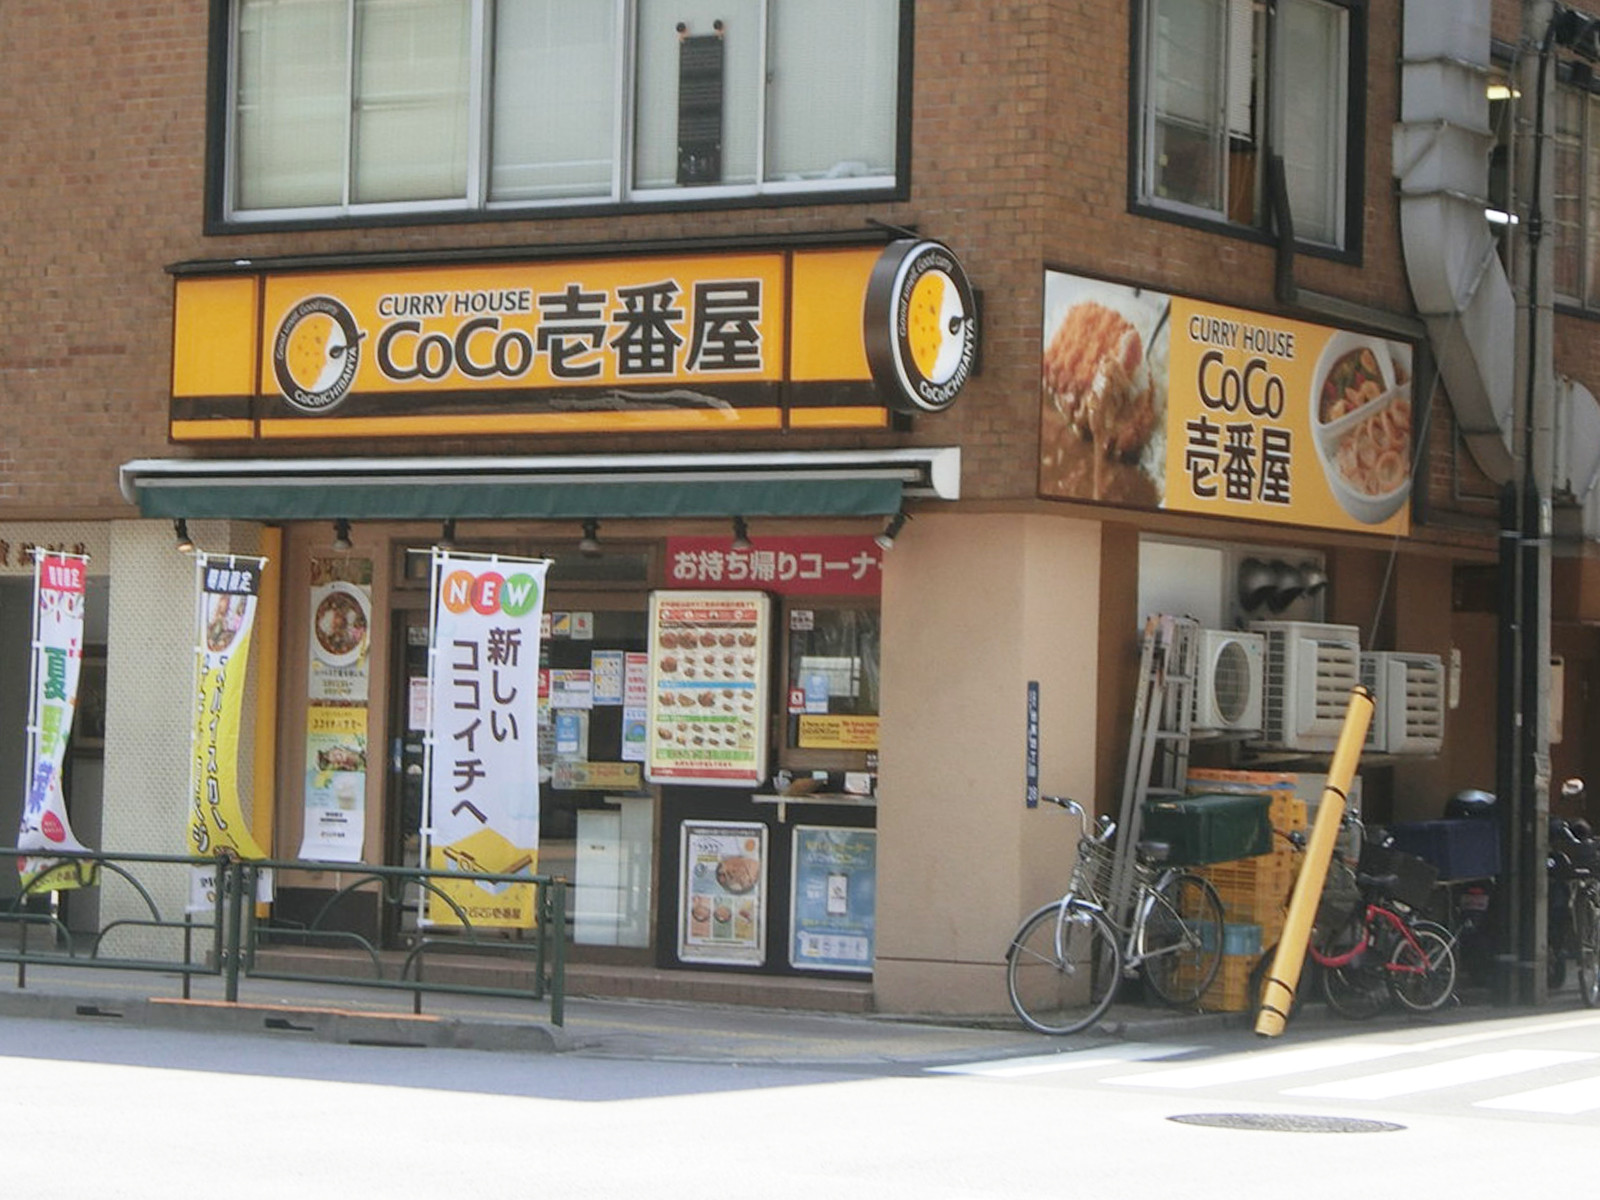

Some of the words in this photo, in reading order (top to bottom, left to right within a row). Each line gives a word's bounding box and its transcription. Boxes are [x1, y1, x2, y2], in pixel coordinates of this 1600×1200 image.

[379, 293, 448, 315] CURRY
[454, 290, 531, 313] HOUSE
[1189, 316, 1238, 348] CURRY
[1243, 327, 1295, 359] HOUSE
[1199, 351, 1284, 418] CoCo
[1186, 416, 1291, 504] 壱番屋
[673, 550, 882, 581] お持ち帰りコーナ
[450, 580, 531, 607] NEW
[487, 627, 522, 743] 新しい
[452, 640, 488, 824] ココイチへ
